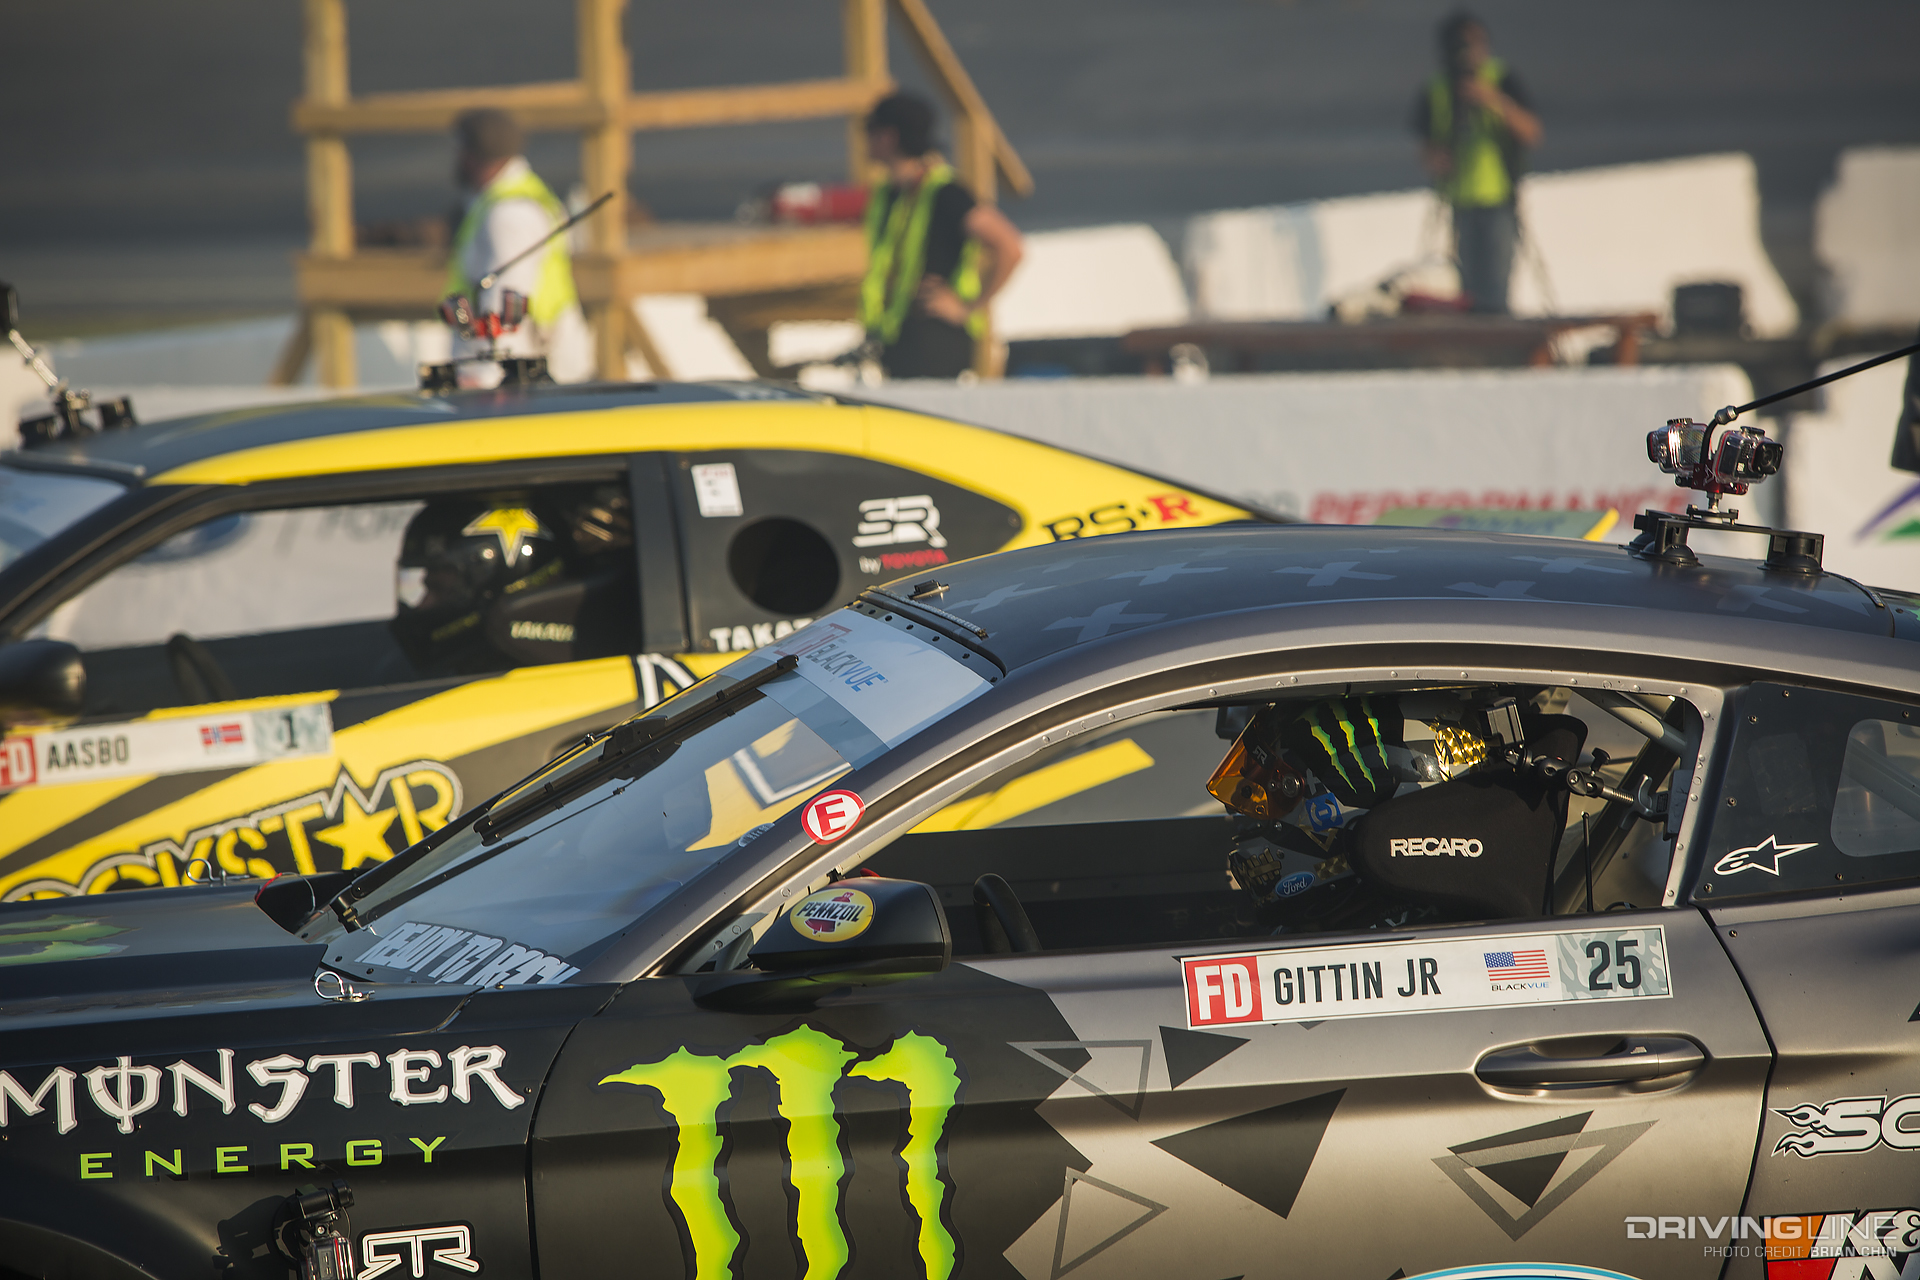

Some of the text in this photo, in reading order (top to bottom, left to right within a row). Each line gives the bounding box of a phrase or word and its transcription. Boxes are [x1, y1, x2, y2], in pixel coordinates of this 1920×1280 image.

[47, 735, 130, 770] AASBO
[813, 797, 847, 837] E
[1389, 837, 1484, 858] RECARO
[1282, 877, 1308, 896] Ford
[795, 900, 866, 923] PENNZOIL
[1194, 939, 1643, 1021] FD GITTIN JR 25
[1491, 981, 1550, 992] BLACKVUE
[0, 1045, 526, 1134] MONSTER
[80, 1136, 446, 1180] ENERGY
